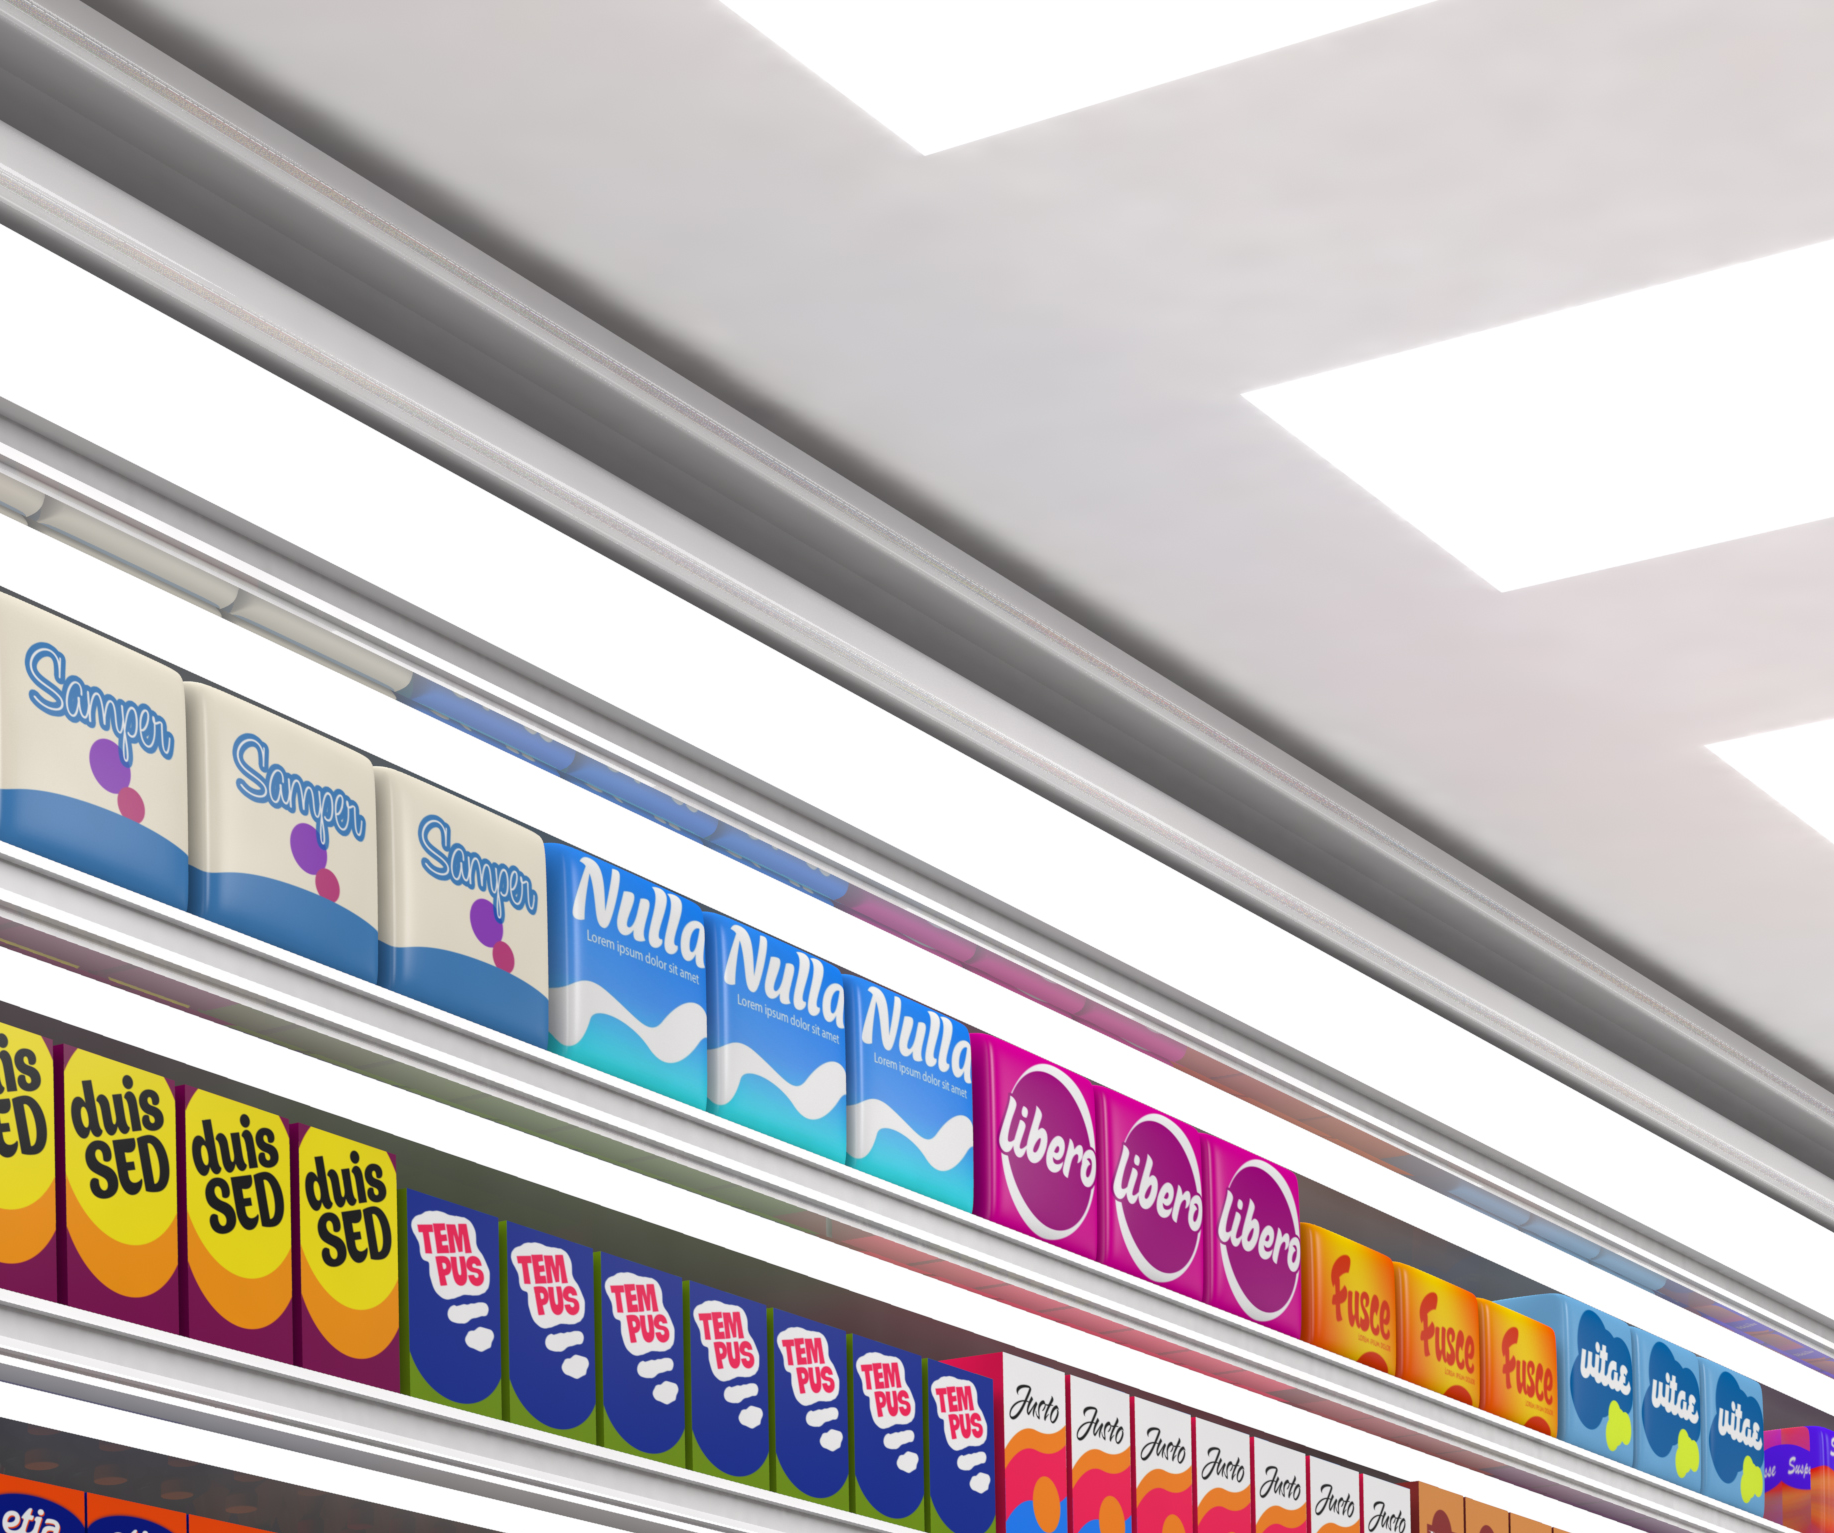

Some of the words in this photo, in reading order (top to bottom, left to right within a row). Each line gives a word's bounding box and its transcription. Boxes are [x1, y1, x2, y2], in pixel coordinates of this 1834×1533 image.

[25, 642, 175, 768] Samper
[572, 857, 705, 968] Nulla
[587, 929, 615, 951] Lorem
[617, 941, 643, 961] ipsum
[645, 953, 667, 970] dolor
[669, 963, 678, 975] sit
[680, 969, 699, 985] amet
[725, 924, 845, 1029] Nulla
[862, 986, 971, 1084] Nulla
[71, 1075, 166, 1139] duis
[85, 1135, 171, 1200] SED
[192, 1114, 280, 1177] duis
[998, 1096, 1097, 1189] libero
[204, 1172, 285, 1235] SED
[304, 1150, 388, 1210] duis
[1113, 1145, 1203, 1232] libero
[317, 1205, 392, 1267] SED
[418, 1222, 472, 1255] TEM
[1217, 1191, 1300, 1273] libero
[435, 1253, 485, 1288] PUS
[517, 1253, 568, 1286] TEM
[610, 1281, 659, 1314] TEM
[1331, 1255, 1390, 1340] Fusce
[534, 1284, 579, 1318] PUS
[625, 1311, 669, 1344] PUS
[1418, 1292, 1475, 1373] Fusce
[1501, 1327, 1554, 1406] Fusce
[1579, 1342, 1631, 1396] vitae
[1009, 1383, 1061, 1425] Justo
[1075, 1405, 1125, 1446] Justo
[1651, 1373, 1699, 1425] vitae
[1718, 1401, 1763, 1450] vitae
